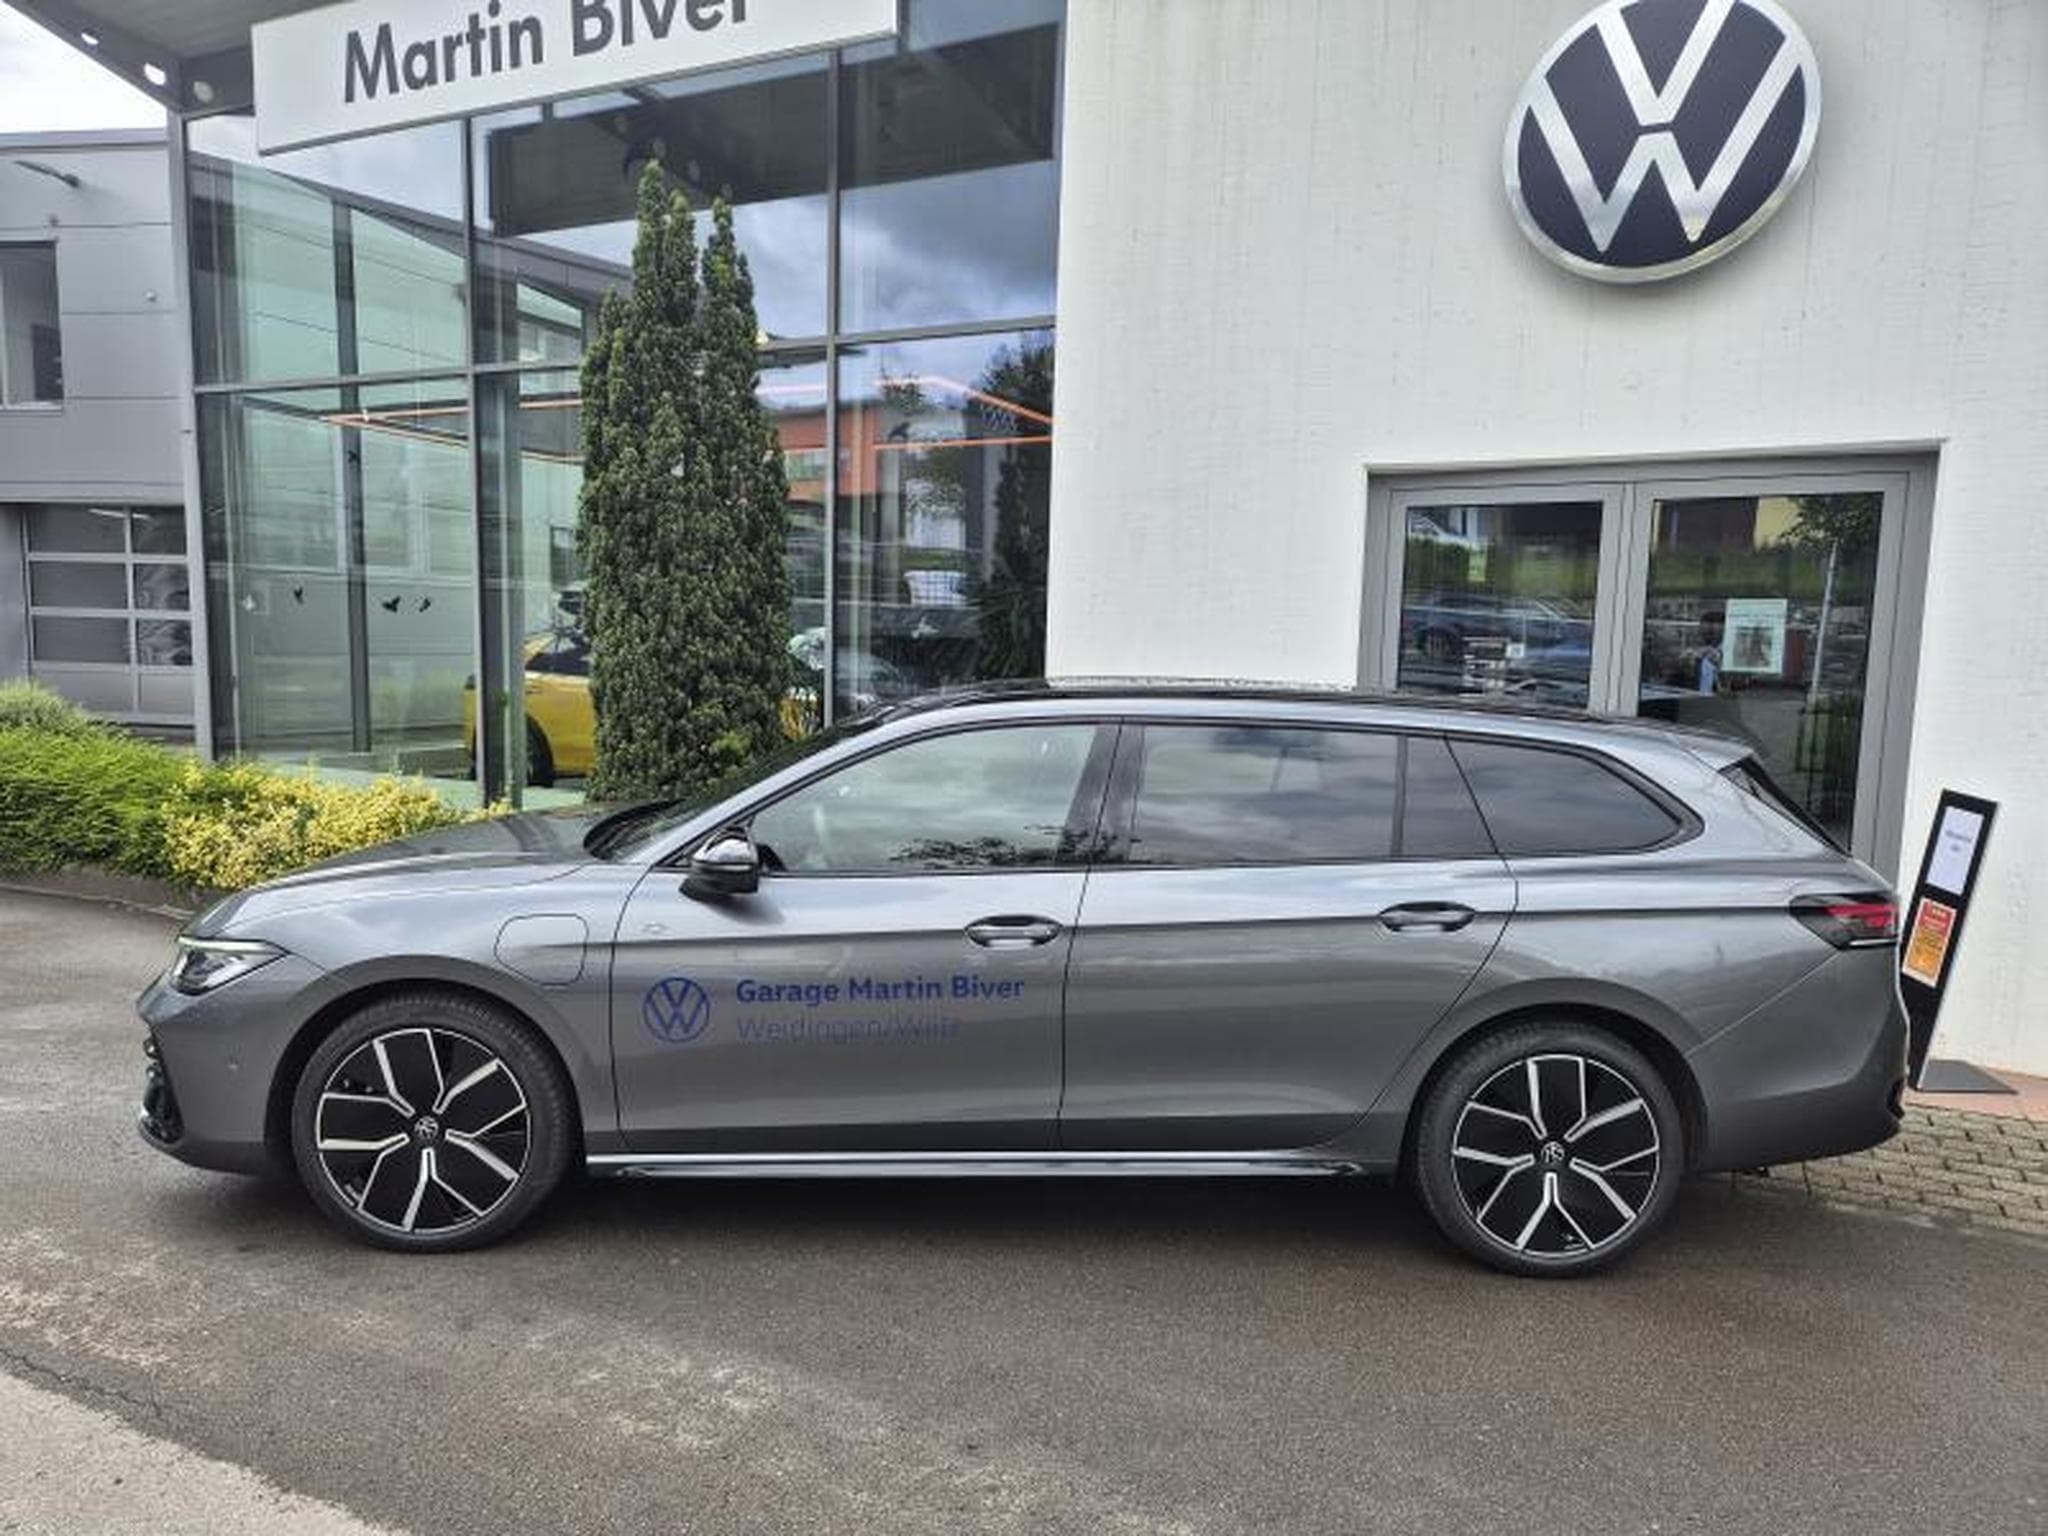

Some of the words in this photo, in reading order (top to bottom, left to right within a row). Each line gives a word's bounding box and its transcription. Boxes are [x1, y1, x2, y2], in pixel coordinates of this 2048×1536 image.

[344, 0, 544, 104] Martin
[736, 978, 839, 1007] Garage
[847, 976, 942, 1000] Martin
[951, 974, 1025, 999] Biver
